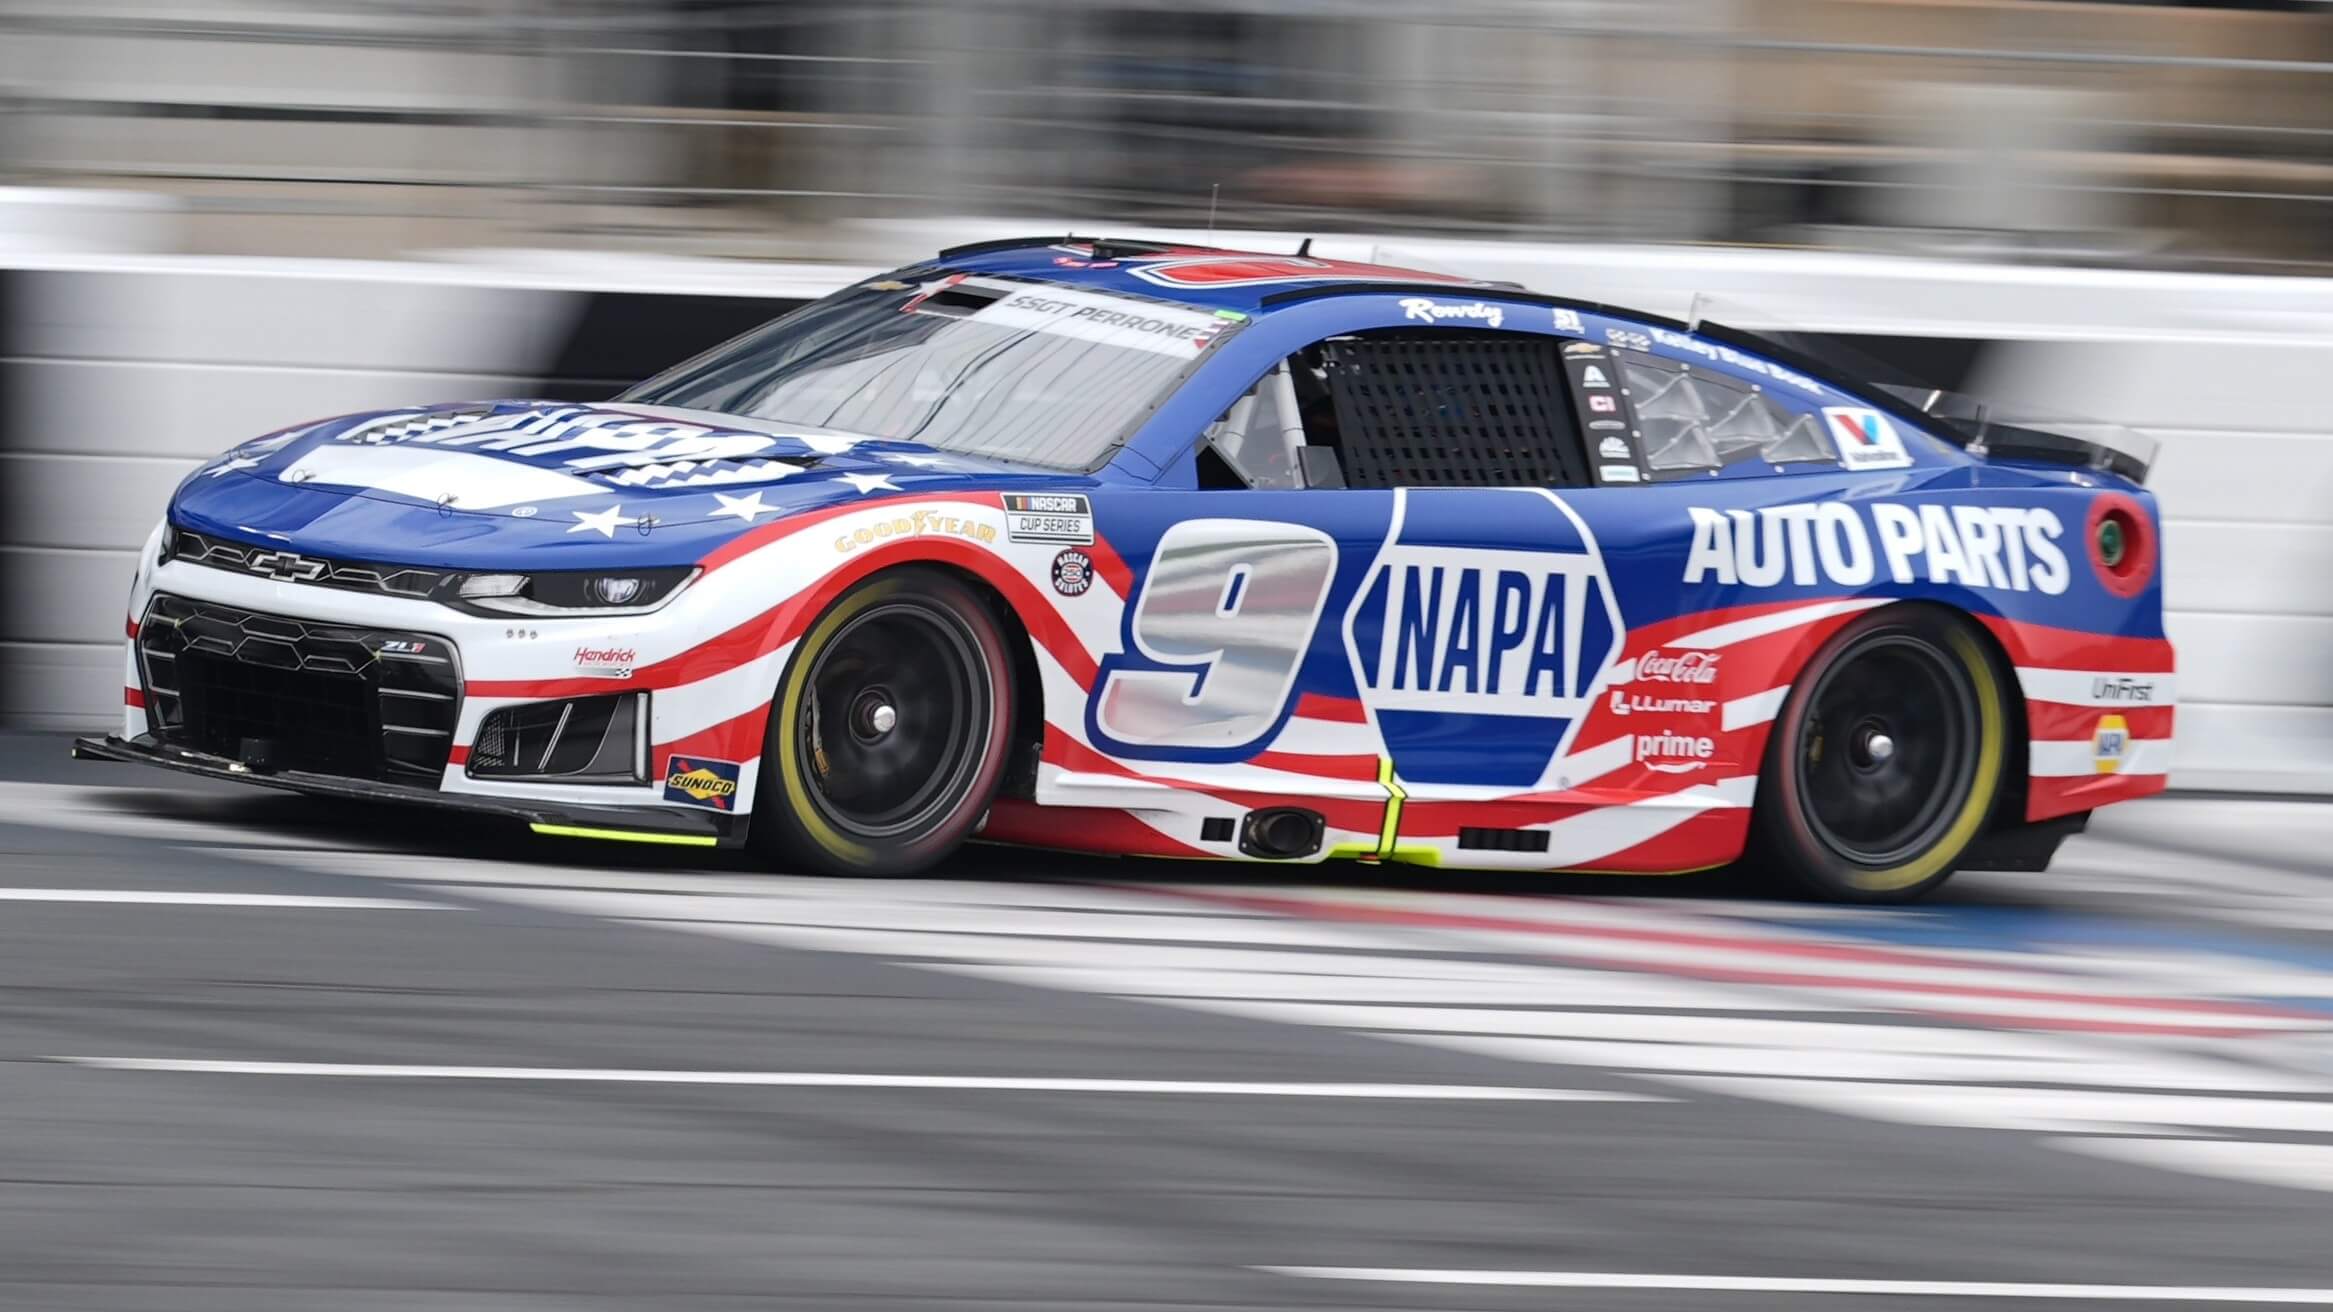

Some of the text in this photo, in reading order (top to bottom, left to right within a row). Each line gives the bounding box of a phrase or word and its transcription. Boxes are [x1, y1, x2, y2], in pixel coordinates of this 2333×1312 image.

[1005, 296, 1200, 340] SSGT PERRONE
[1398, 299, 1503, 328] Rowdy
[1031, 497, 1077, 512] NASCAR
[835, 510, 997, 552] GOODYEAR
[1020, 518, 1080, 533] CUP SERIES
[1683, 502, 2070, 595] AUTO PARTS
[1094, 519, 1338, 758] 9
[1389, 565, 1571, 697] NAPA
[574, 647, 635, 665] Hendrick
[1637, 729, 1714, 761] prime
[671, 775, 733, 793] SUNOCO
